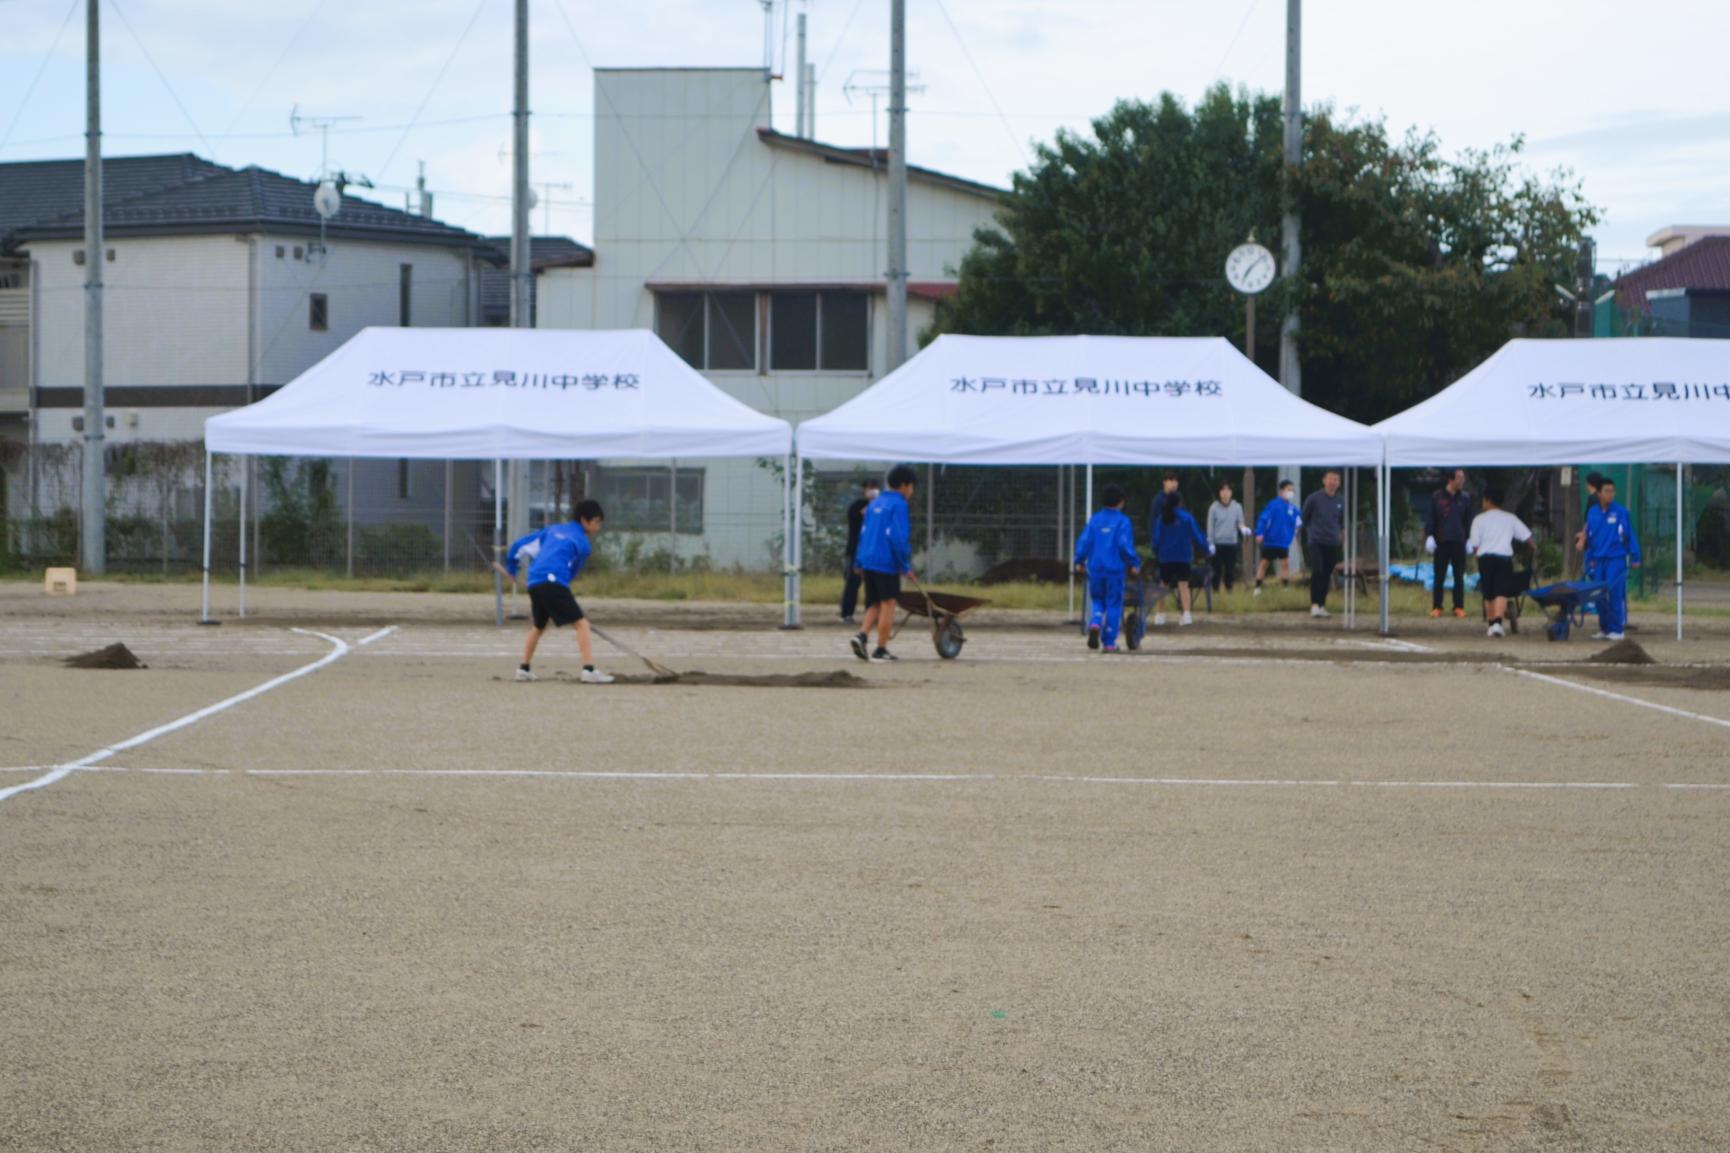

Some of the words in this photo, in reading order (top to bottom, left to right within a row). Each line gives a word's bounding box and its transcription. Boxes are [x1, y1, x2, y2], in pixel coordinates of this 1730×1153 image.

[368, 370, 641, 390] 水戸市立見川中学校
[950, 376, 1223, 397] 水戸市立見川中学校
